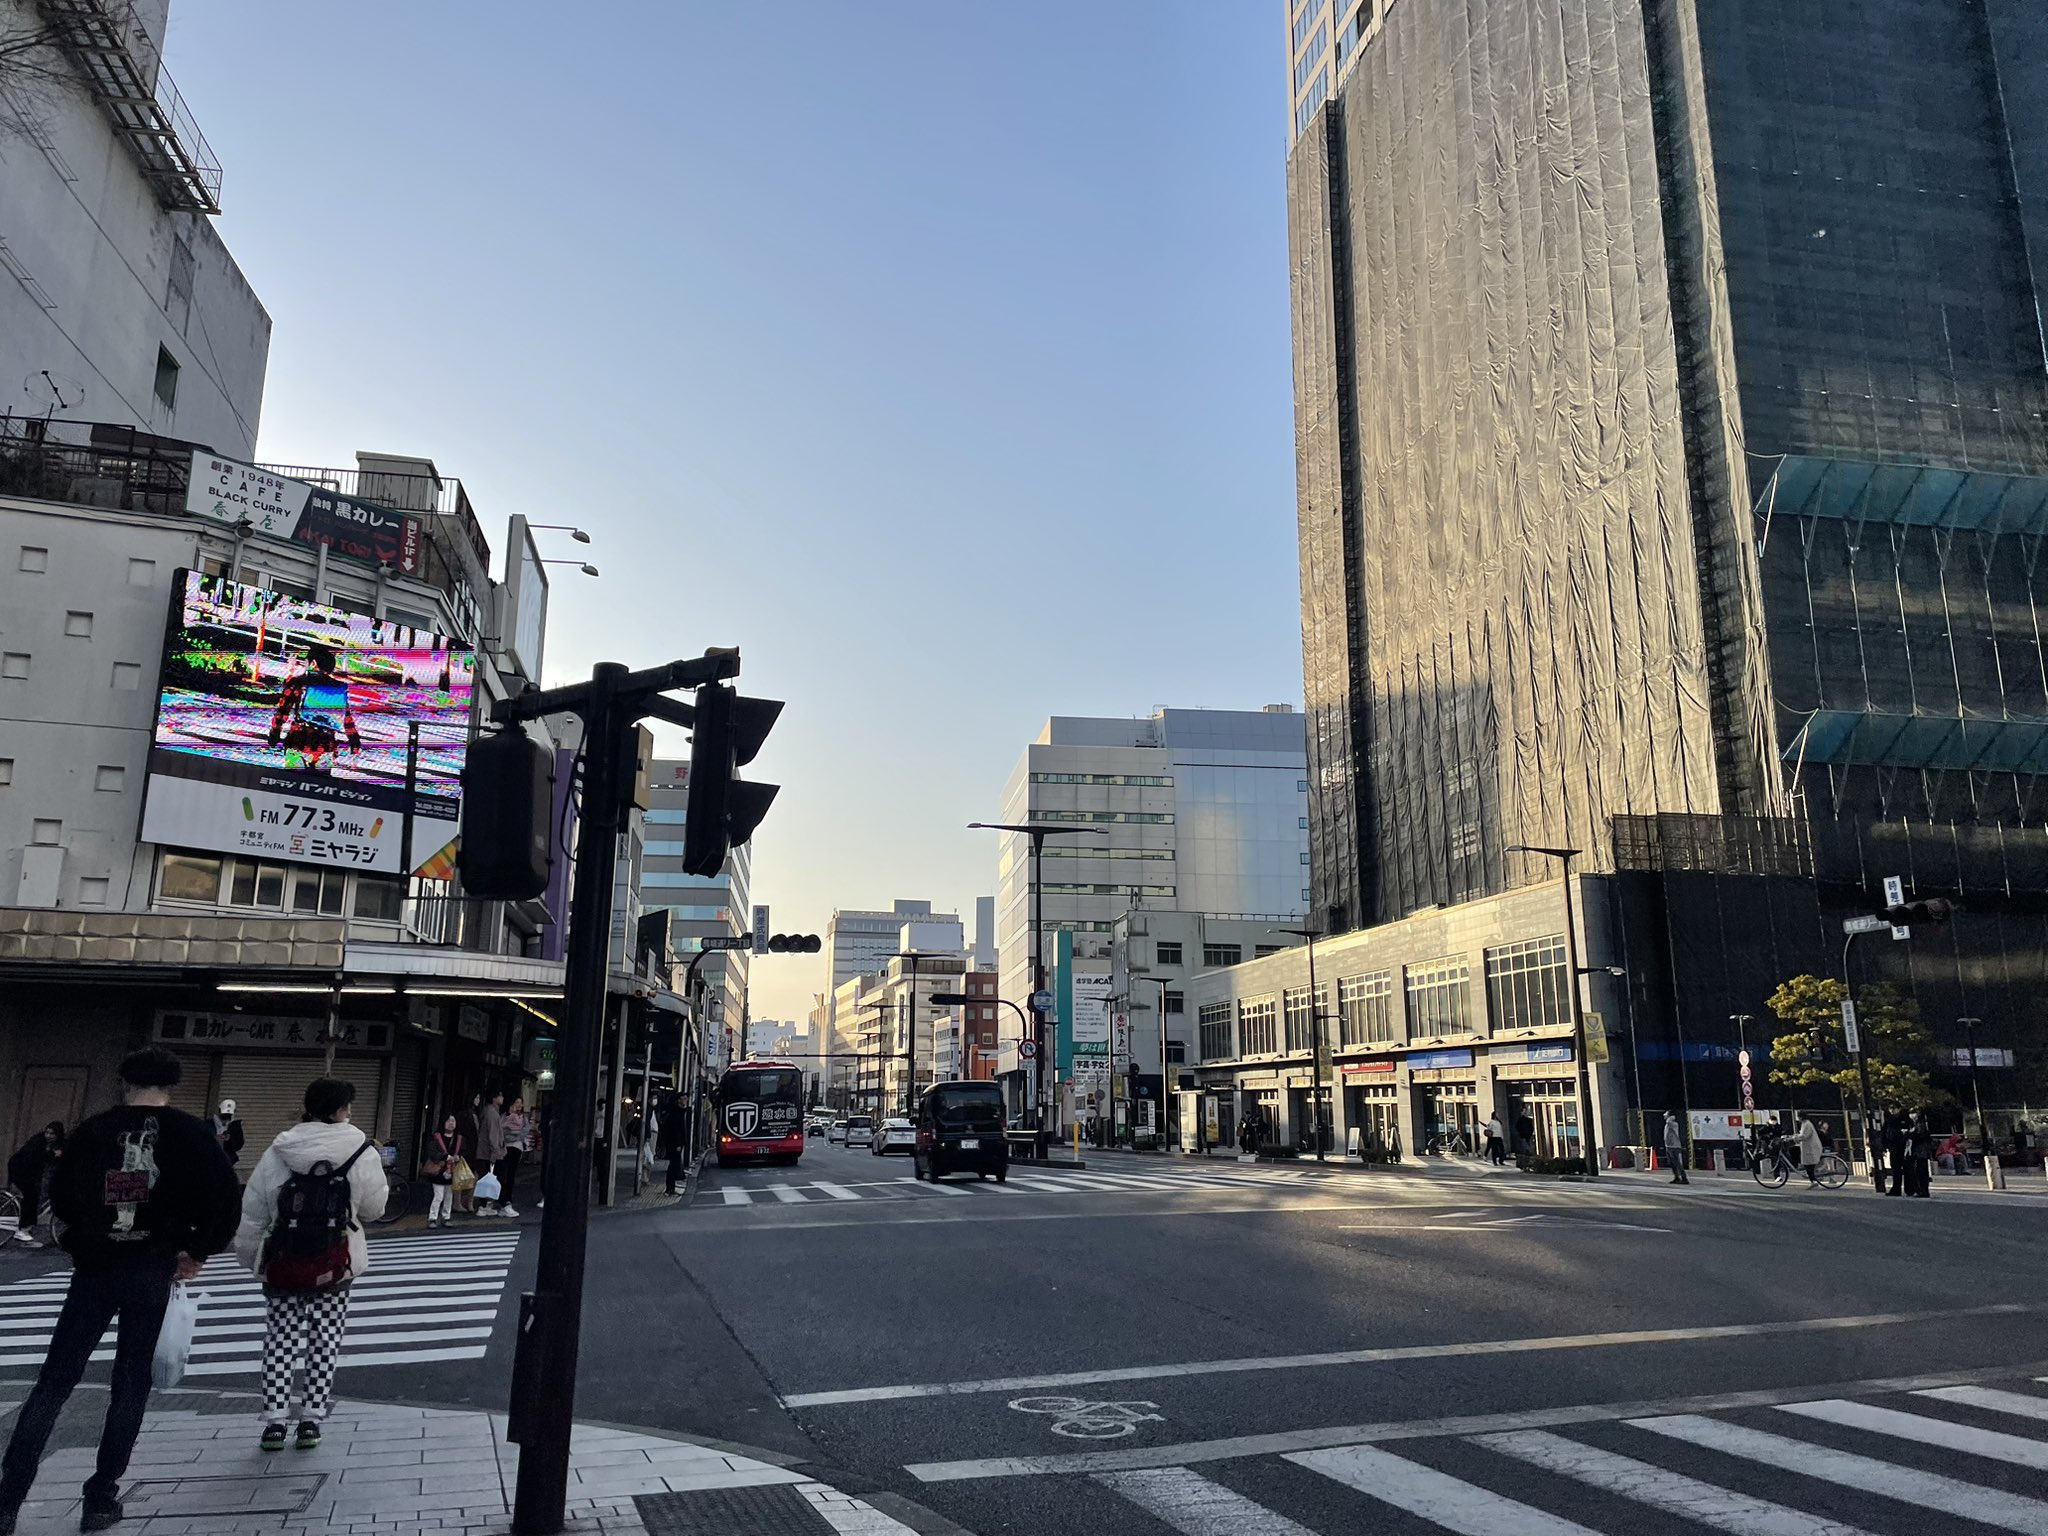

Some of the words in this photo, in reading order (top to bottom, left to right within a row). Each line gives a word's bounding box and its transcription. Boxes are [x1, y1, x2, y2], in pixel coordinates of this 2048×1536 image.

[241, 470, 286, 491] 1948年
[208, 486, 249, 505] BLACK
[252, 500, 292, 518] CURRY
[335, 501, 400, 528] 黒カレー
[259, 776, 297, 789] ミヤラジ
[260, 809, 279, 825] FM
[283, 803, 336, 832] 77.3
[338, 821, 365, 837] MHz
[311, 839, 379, 864] ミヤラジ
